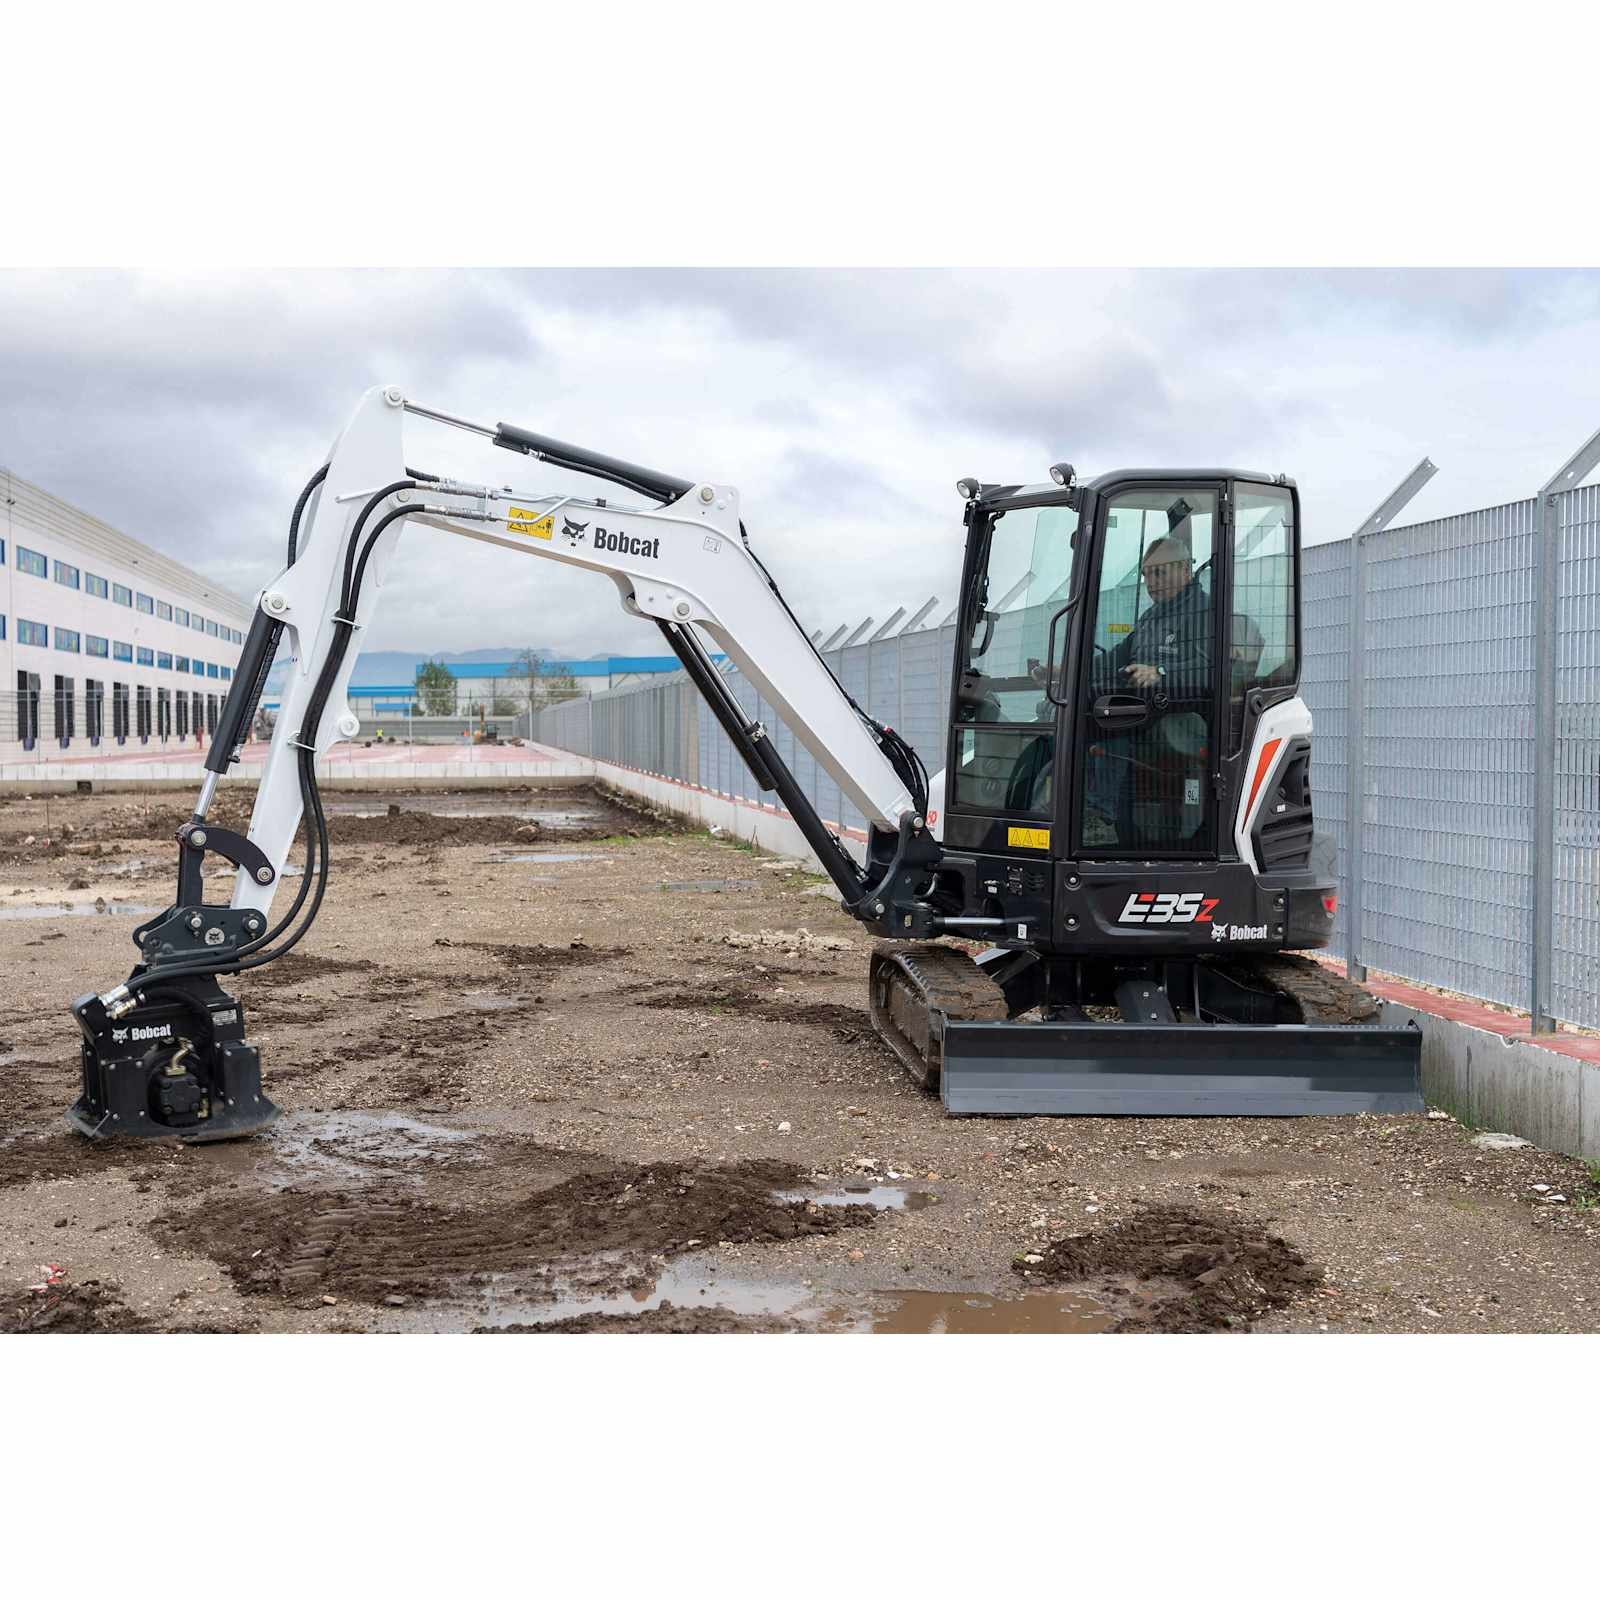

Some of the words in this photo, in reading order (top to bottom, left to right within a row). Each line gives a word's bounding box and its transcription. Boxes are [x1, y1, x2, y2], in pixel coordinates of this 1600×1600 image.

[594, 527, 660, 559] Bobcat
[1229, 924, 1268, 941] Bobcat
[131, 1023, 172, 1041] Bobcat
